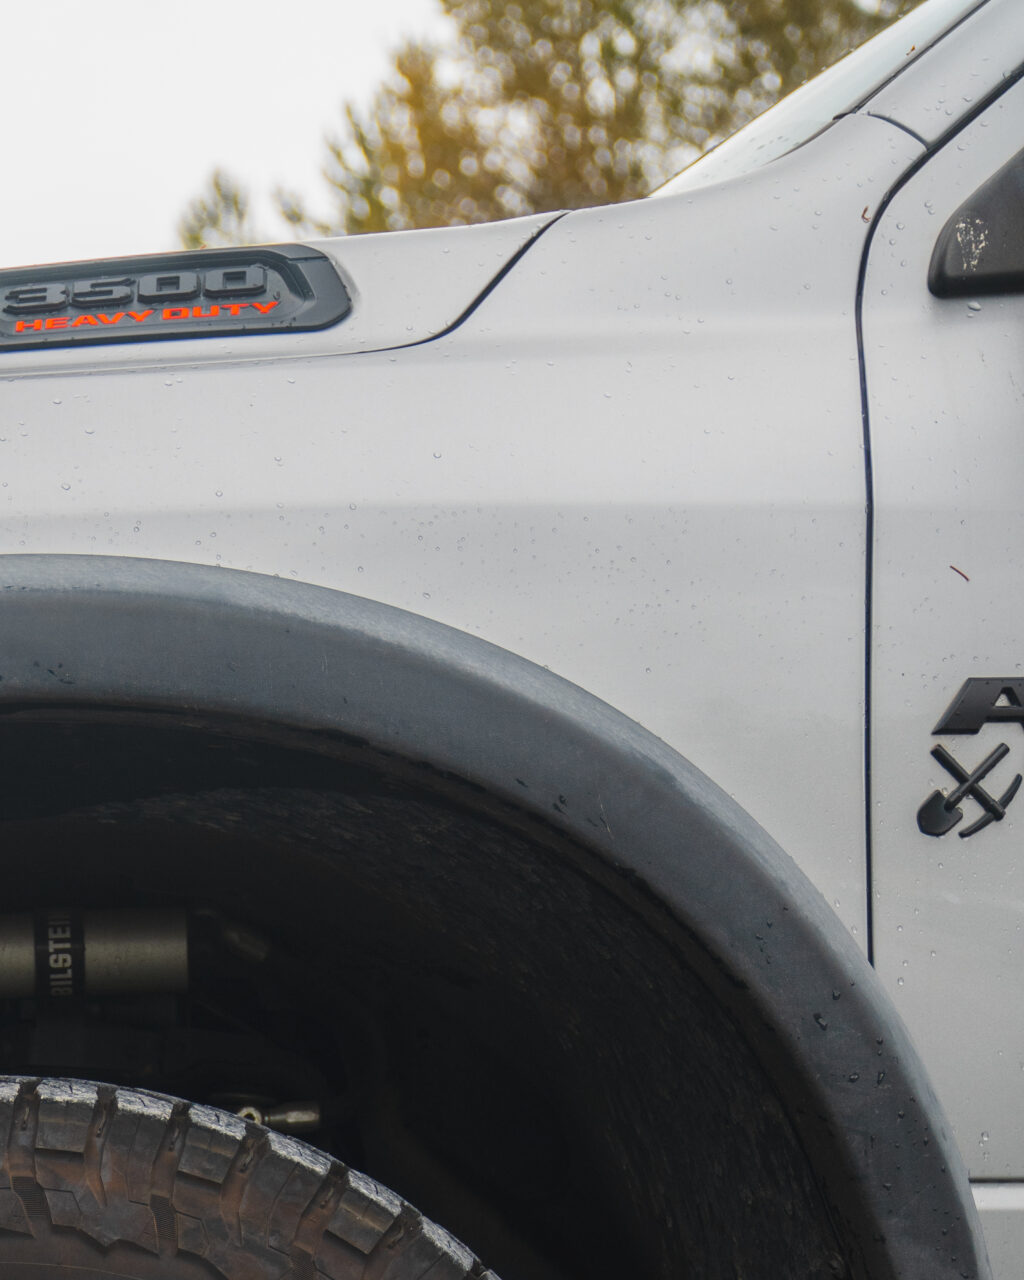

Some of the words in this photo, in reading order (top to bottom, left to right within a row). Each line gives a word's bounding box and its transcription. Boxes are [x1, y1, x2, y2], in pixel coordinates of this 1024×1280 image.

[3, 264, 268, 315] 3500
[15, 309, 154, 333] HEAVY
[162, 301, 279, 321] DUTY
